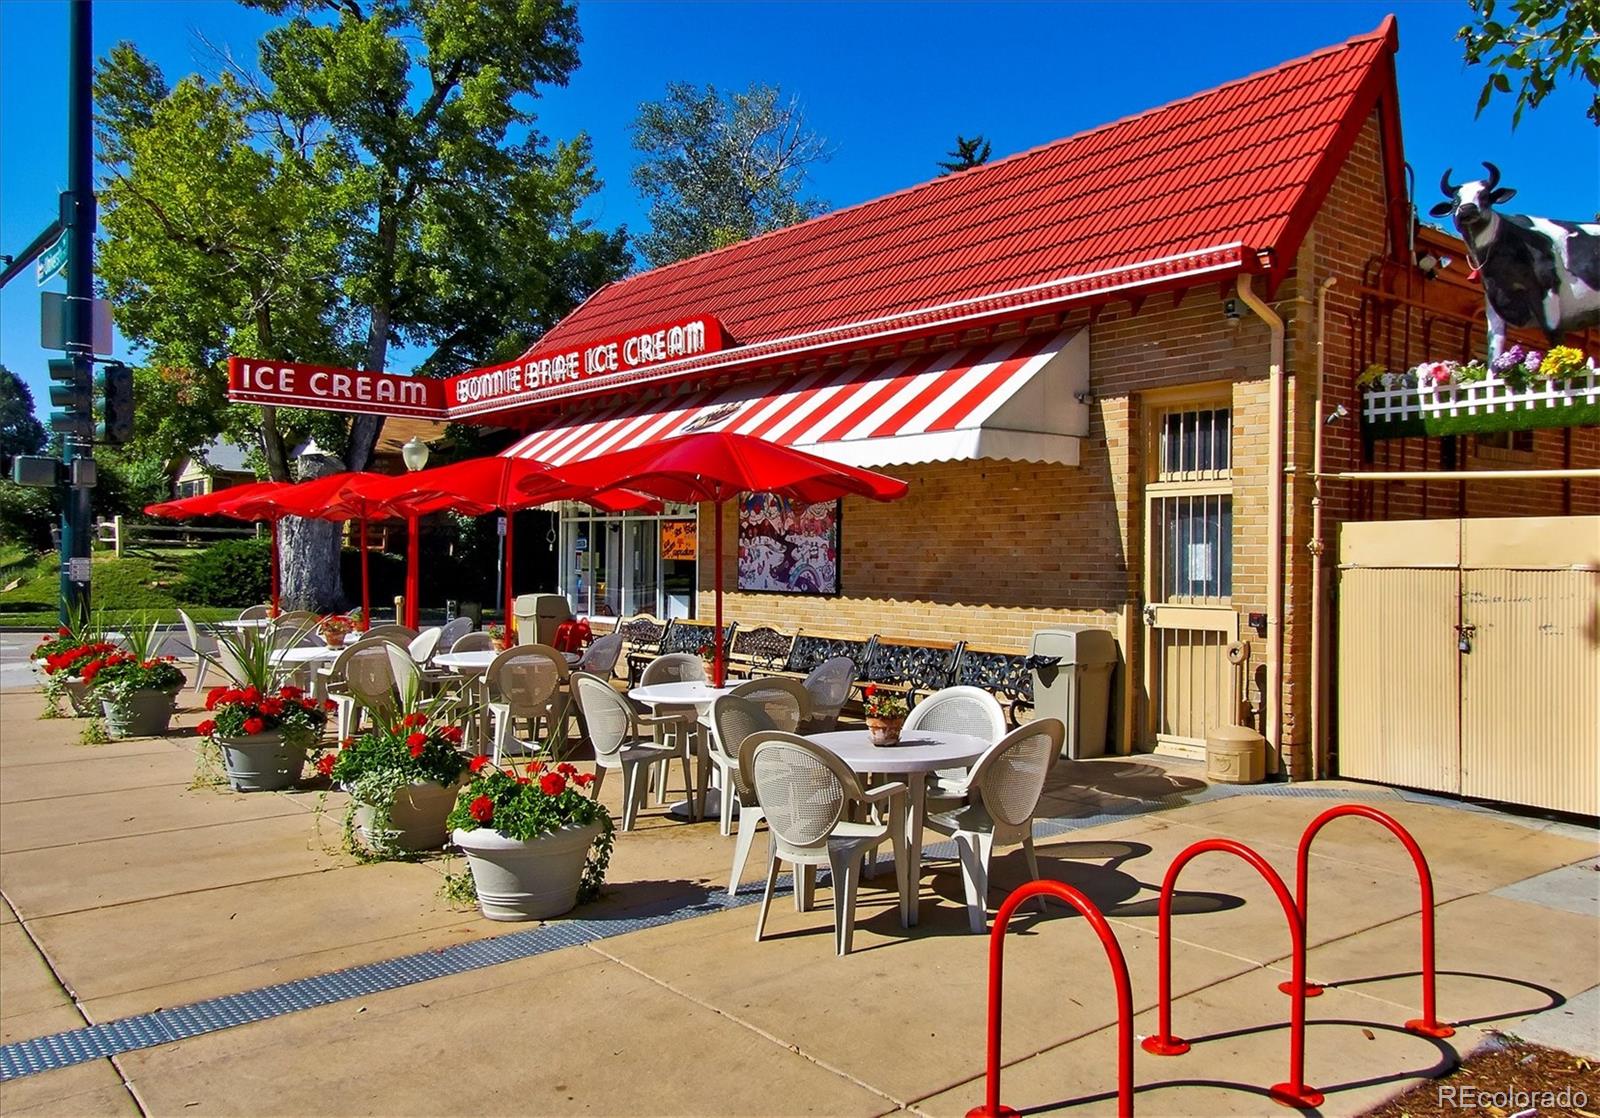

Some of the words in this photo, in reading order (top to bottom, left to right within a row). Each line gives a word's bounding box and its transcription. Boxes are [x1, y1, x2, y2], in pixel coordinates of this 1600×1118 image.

[243, 364, 295, 392] ICE
[309, 372, 427, 406] CREAM
[456, 365, 521, 403] BONNIE
[524, 352, 580, 388] BRAE
[585, 342, 619, 375] ICE
[624, 320, 705, 365] CREAM
